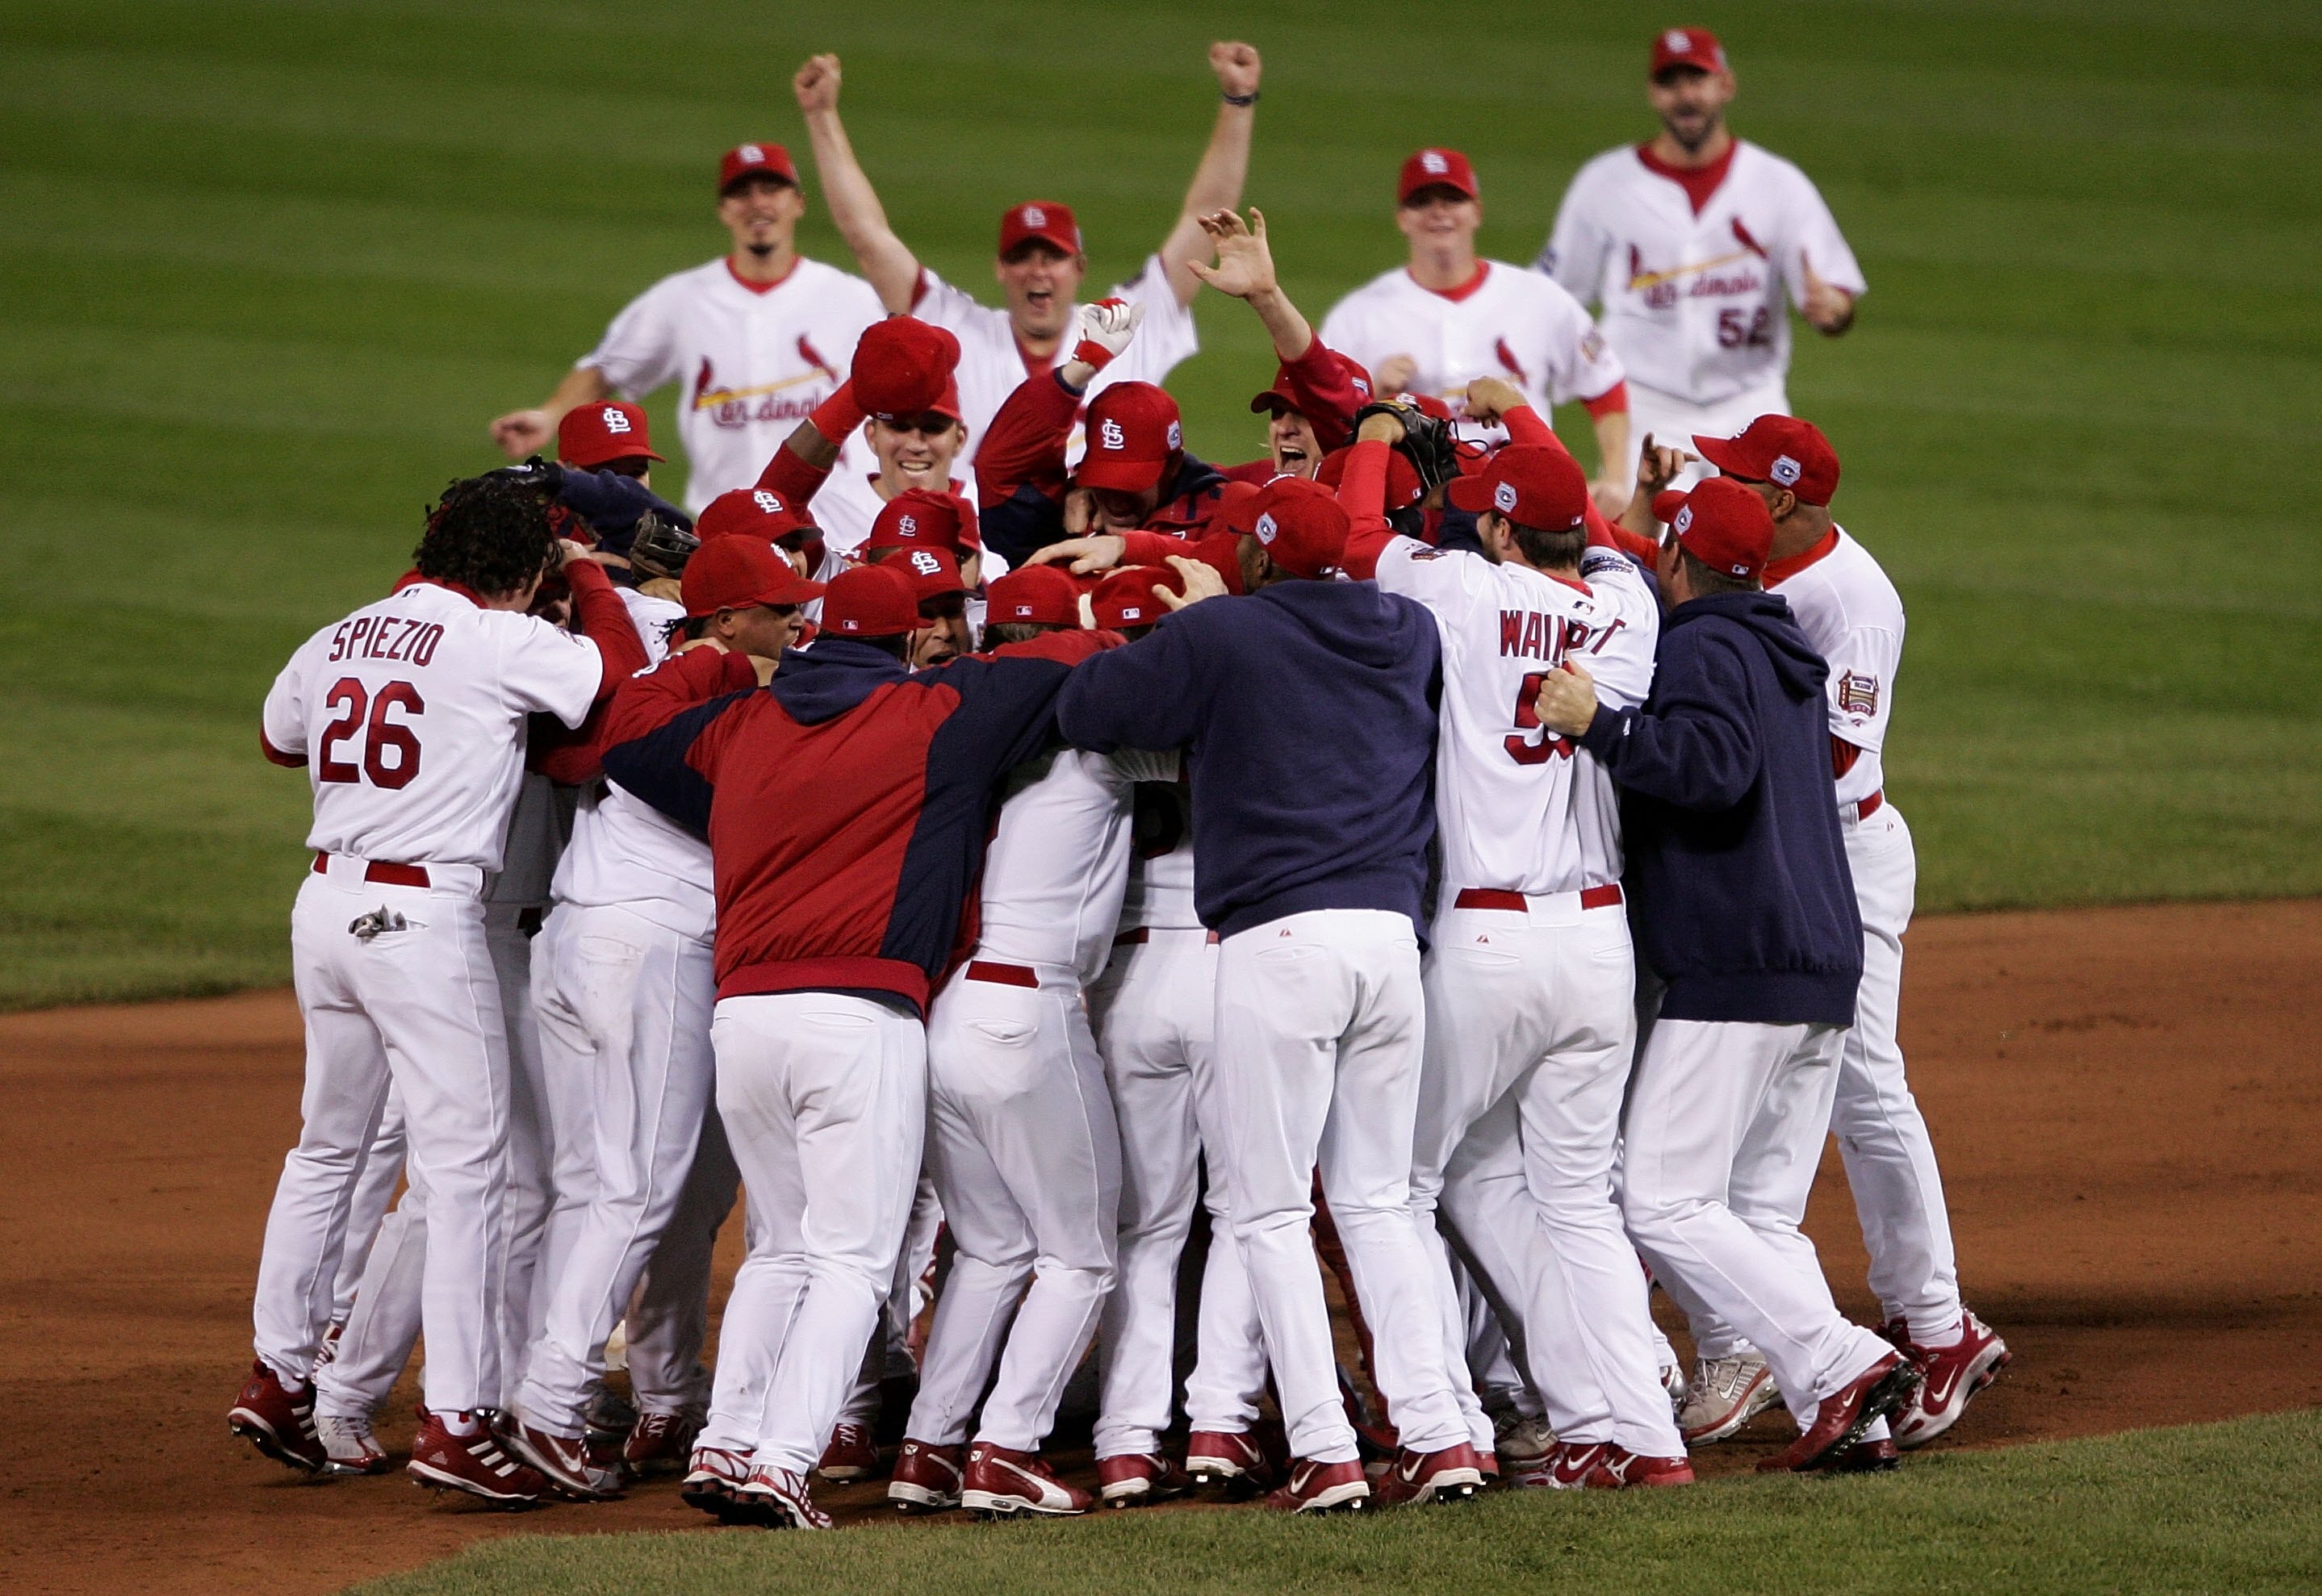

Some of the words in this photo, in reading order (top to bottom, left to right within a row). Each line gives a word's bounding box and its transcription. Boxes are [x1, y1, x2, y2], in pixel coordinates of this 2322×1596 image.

[1718, 307, 1771, 349] 52
[710, 385, 822, 429] Cardinal
[328, 616, 445, 667] SPIEZIO
[319, 676, 425, 790] 26
